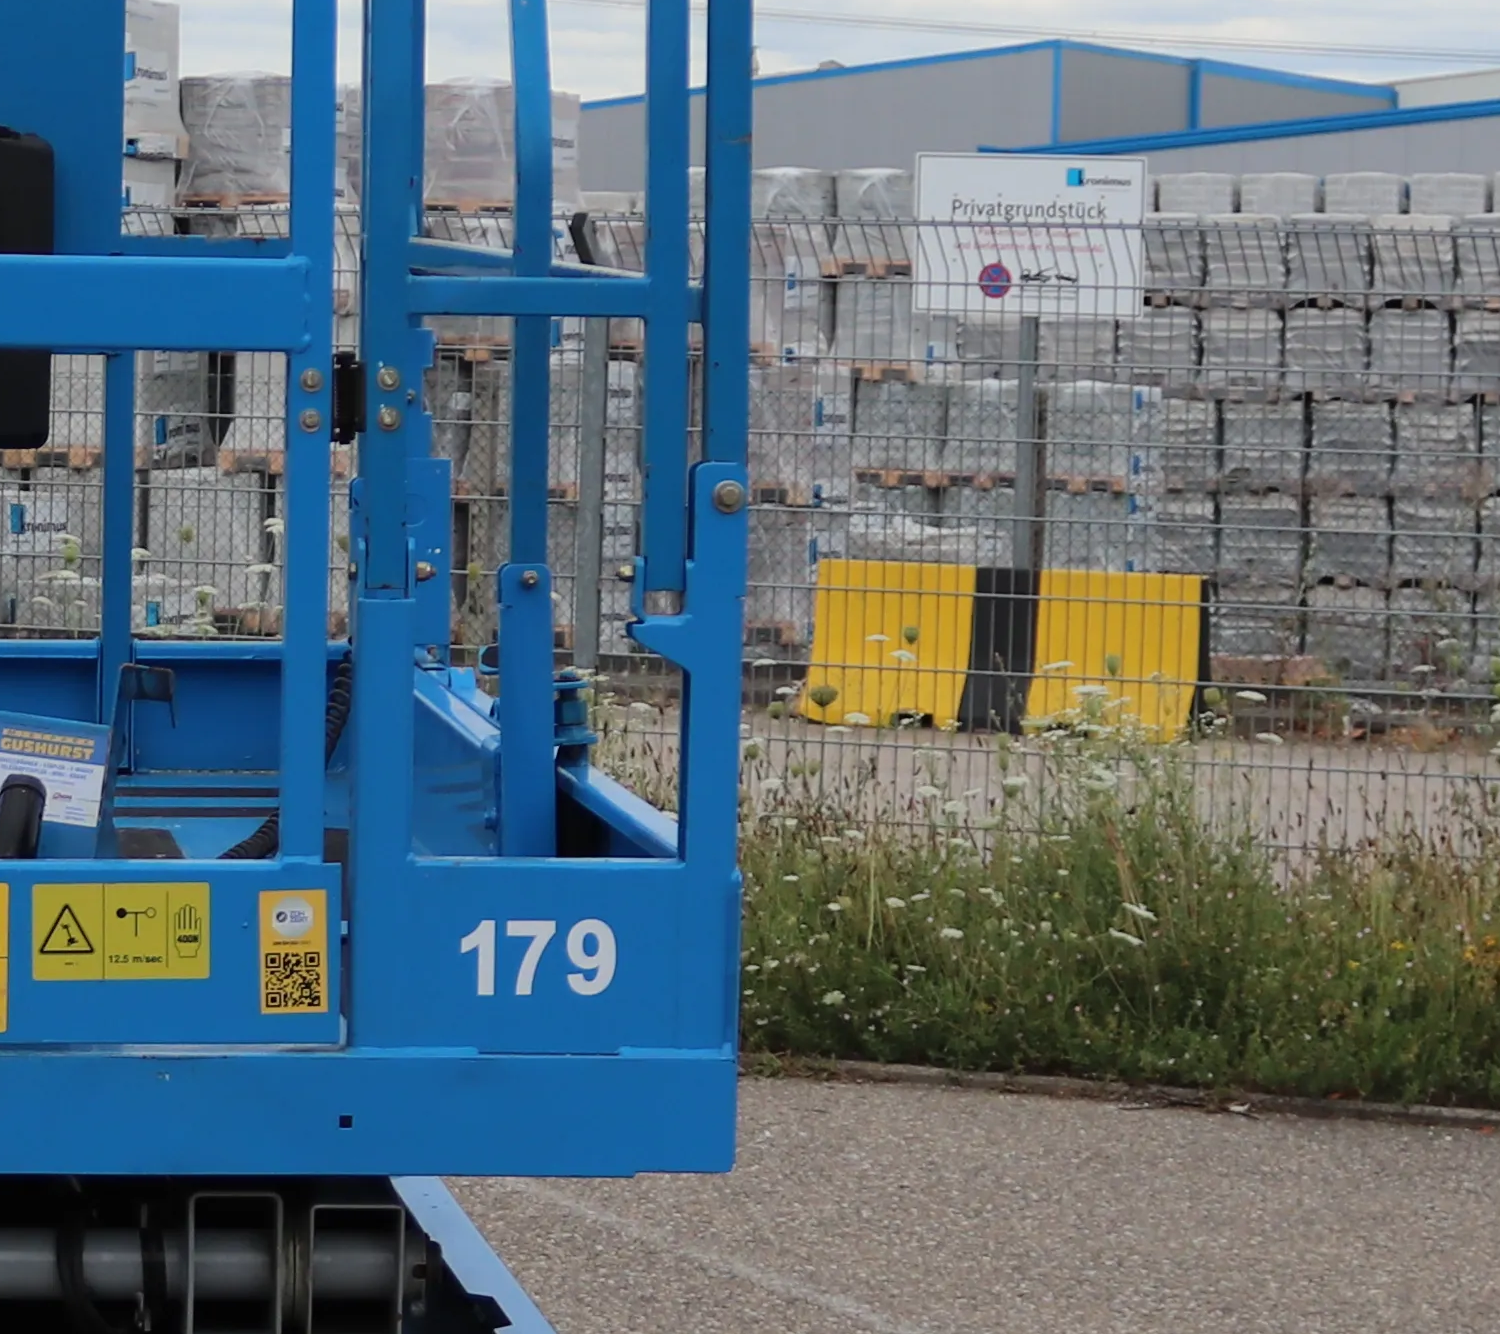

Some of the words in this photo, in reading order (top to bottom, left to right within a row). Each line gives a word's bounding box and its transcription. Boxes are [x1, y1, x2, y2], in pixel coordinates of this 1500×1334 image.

[952, 199, 1107, 221] Privatgrundstück
[1, 737, 95, 760] GUSHURST
[108, 955, 129, 963] 12.5
[132, 955, 163, 964] m/sec
[460, 919, 617, 996] 179
